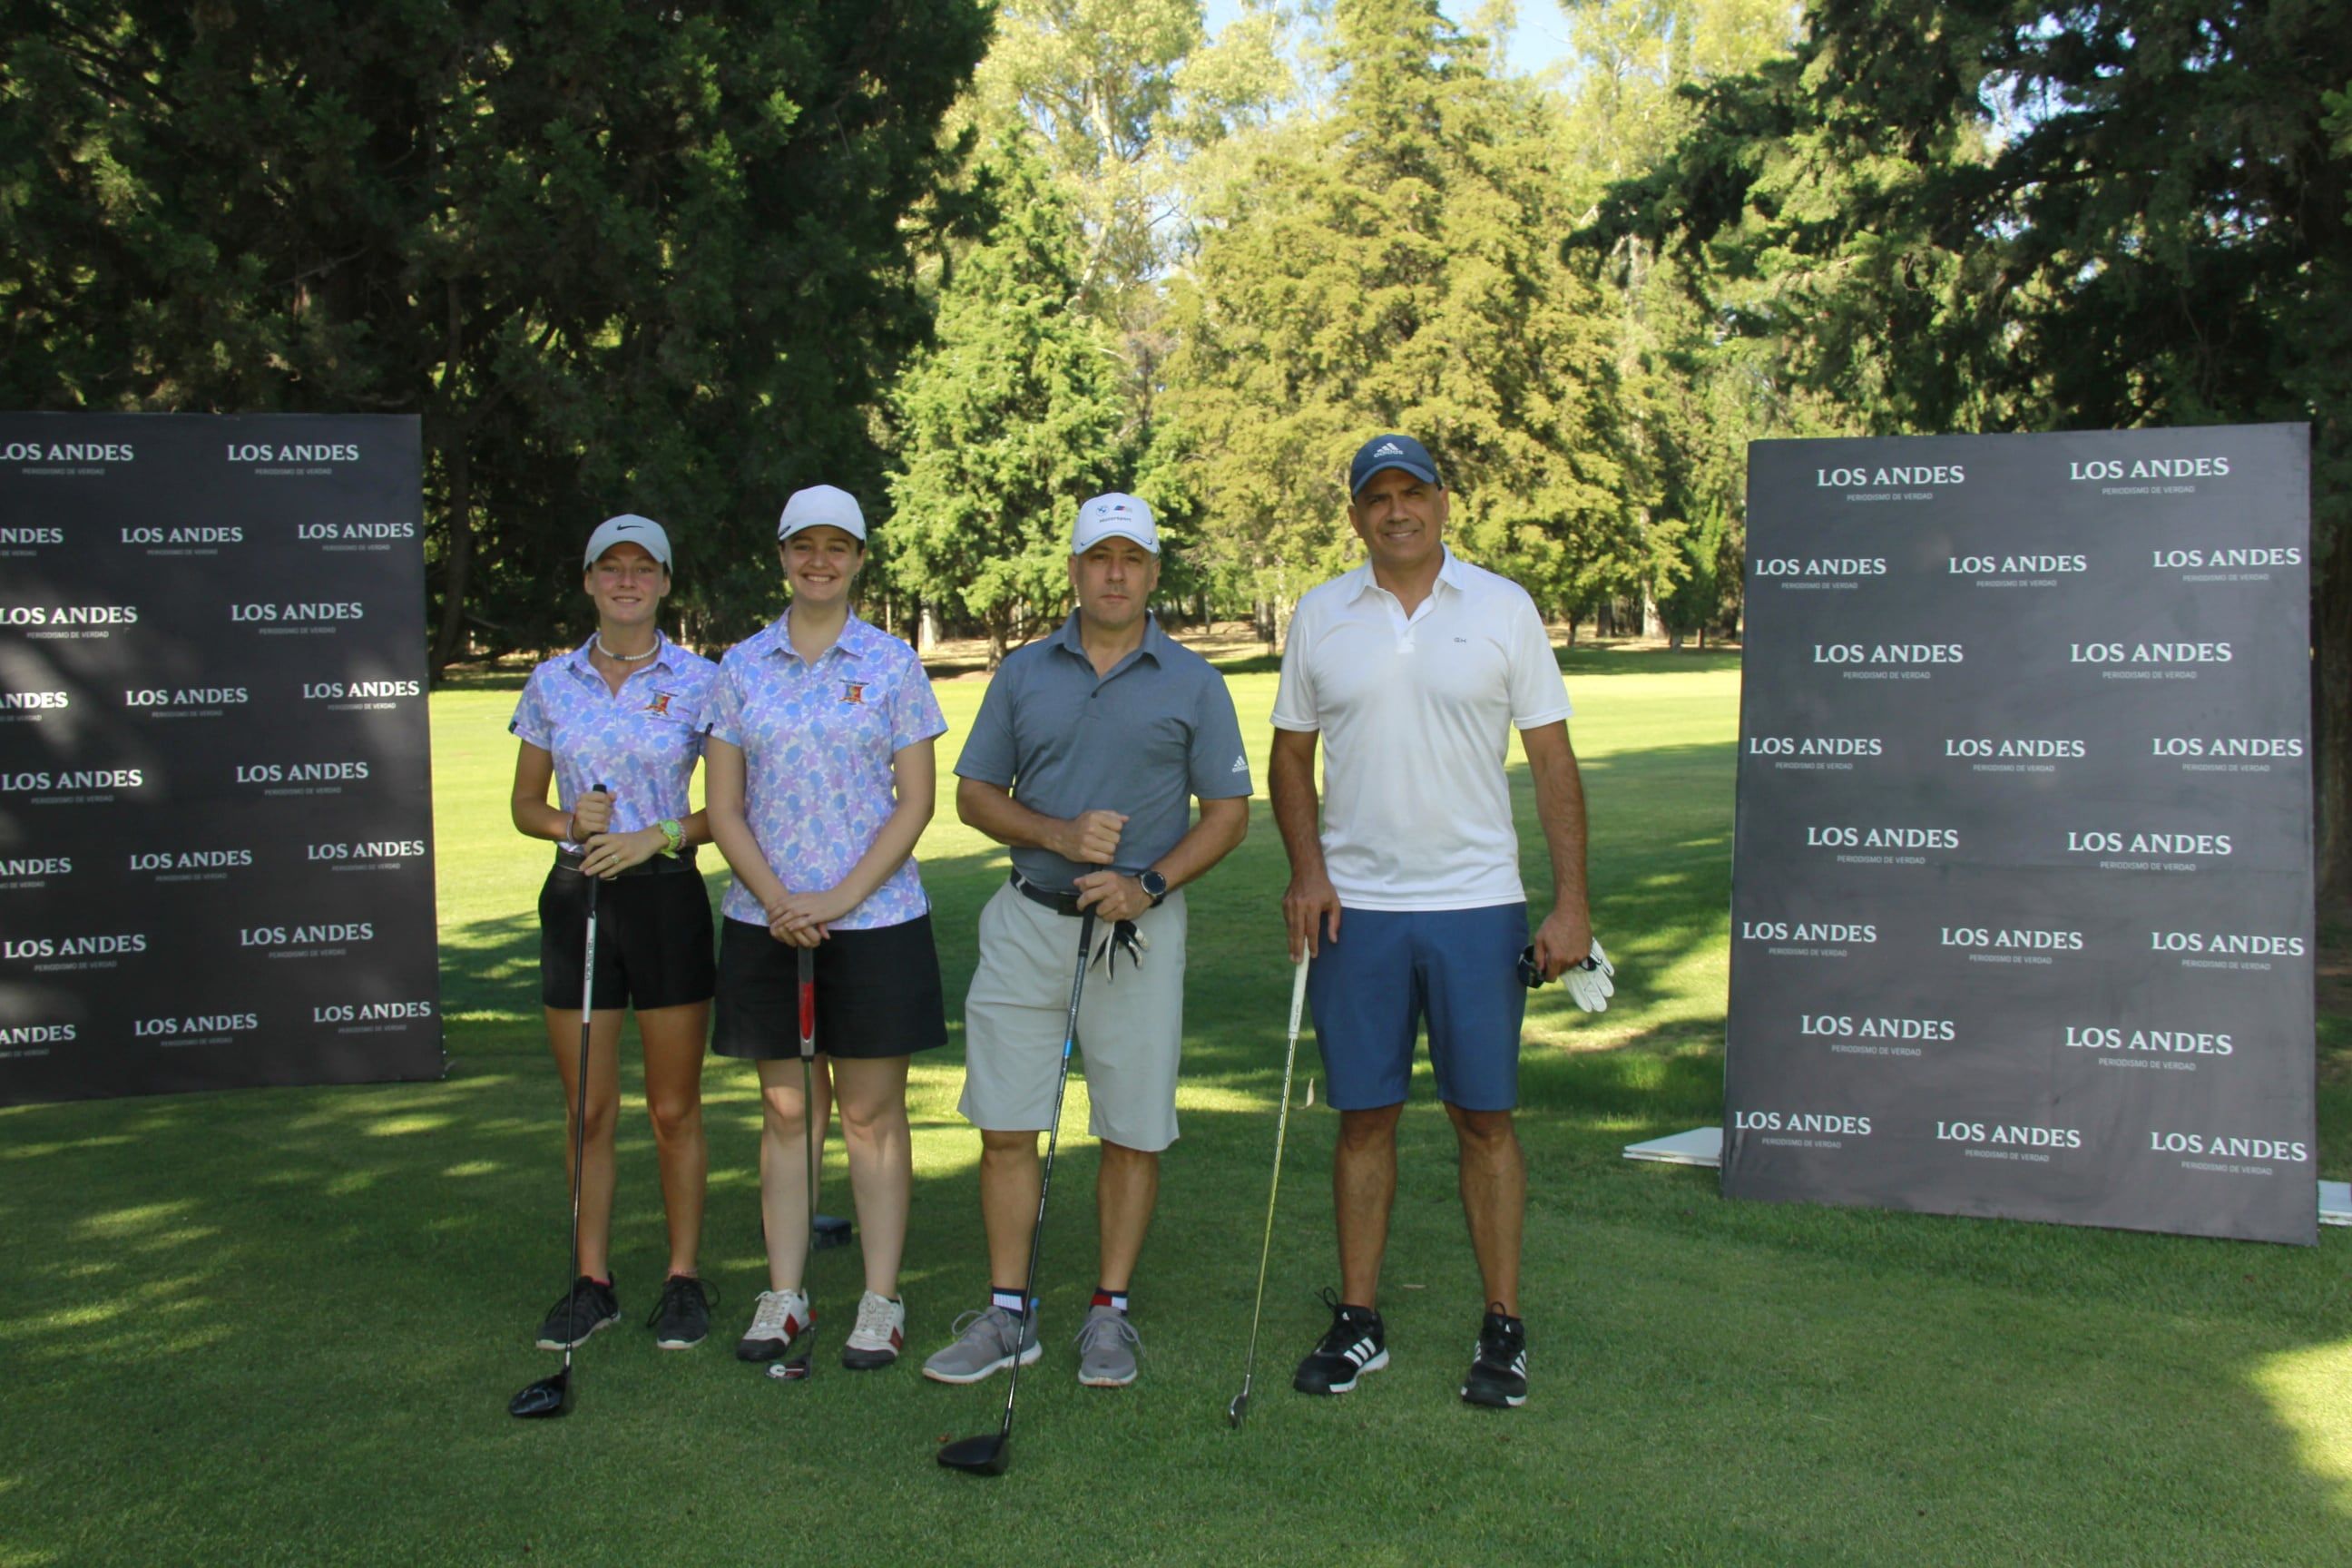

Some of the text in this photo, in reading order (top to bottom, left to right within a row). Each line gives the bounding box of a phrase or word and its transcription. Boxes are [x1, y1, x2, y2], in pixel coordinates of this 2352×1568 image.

[47, 443, 134, 461] ANDES
[227, 444, 359, 461] LOS ANDES
[1817, 466, 1965, 487] LOS ANDES
[2069, 456, 2230, 481] LOS ANDES
[1847, 494, 1890, 502] PERIODISMO
[1904, 493, 1933, 501] VERDAD
[2102, 487, 2150, 495] PERIODISMO
[2163, 485, 2195, 494] VERDAD
[0, 527, 62, 544] NDES
[121, 526, 243, 543] LOS ANDES
[298, 523, 414, 539] LOS ANDES
[1755, 558, 1886, 575] LOS ANDES
[1948, 554, 2087, 573] LOS ANDES
[2152, 547, 2301, 568] LOS ANDES
[0, 606, 138, 624] LOS ANDES
[231, 602, 363, 621] LOS ANDES
[1813, 643, 1964, 663] LOS ANDES
[2070, 642, 2233, 662] LOS ANDES
[1901, 671, 1931, 680] VERDAD
[125, 687, 248, 706] LOS ANDES
[303, 681, 419, 699] LOS ANDES
[1749, 737, 1883, 756] LOS ANDES
[1945, 739, 2085, 758] LOS ANDES
[2152, 738, 2303, 757] LOS ANDES
[236, 761, 368, 782] LOS ANDES
[1973, 764, 2014, 772] PERIODISMO
[2, 769, 142, 791] LOS ANDES
[1807, 827, 1959, 849] LOS ANDES
[2067, 831, 2232, 856] LOS ANDES
[130, 849, 252, 870] LOS ANDES
[308, 840, 424, 860] LOS ANDES
[1837, 856, 1882, 864] PERIODISMO
[1896, 857, 1926, 865] VERDAD
[2100, 861, 2196, 872] PERIODISMO DE VERDAD
[240, 922, 374, 946] LOS ANDES
[1742, 921, 1877, 943] LOS ANDES
[1940, 927, 2083, 950] LOS ANDES
[5, 934, 147, 958] LOS ANDES
[1769, 947, 1808, 956] PERIODISMO
[1820, 949, 1847, 957] VERDAD
[2151, 931, 2304, 956] LOS ANDES
[1969, 955, 2012, 963] PERIODISMO
[2024, 956, 2052, 965] VERDAD
[2181, 960, 2227, 969] PERIODISMO
[2240, 963, 2270, 971] VERDAD
[313, 1001, 431, 1023] LOS ANDES
[134, 1013, 258, 1035] LOS ANDES
[1800, 1014, 1955, 1041] LOS ANDES
[1831, 1044, 1921, 1057] PERIODISMO DE VERDAD
[2065, 1026, 2233, 1056] LOS ANDES
[2098, 1058, 2196, 1072] PERIODISMO DE VERDAD
[1735, 1111, 1871, 1135] LOS ANDES
[1762, 1138, 1841, 1149] PERIODISMO DE VERDAD
[1936, 1121, 2082, 1149] LOS ANDES
[1965, 1150, 2049, 1162] PERIODISMO DE VERDAD
[2150, 1131, 2307, 1162] LOS ANDES
[2181, 1161, 2273, 1176] PERIODISMO DE VERDAD
